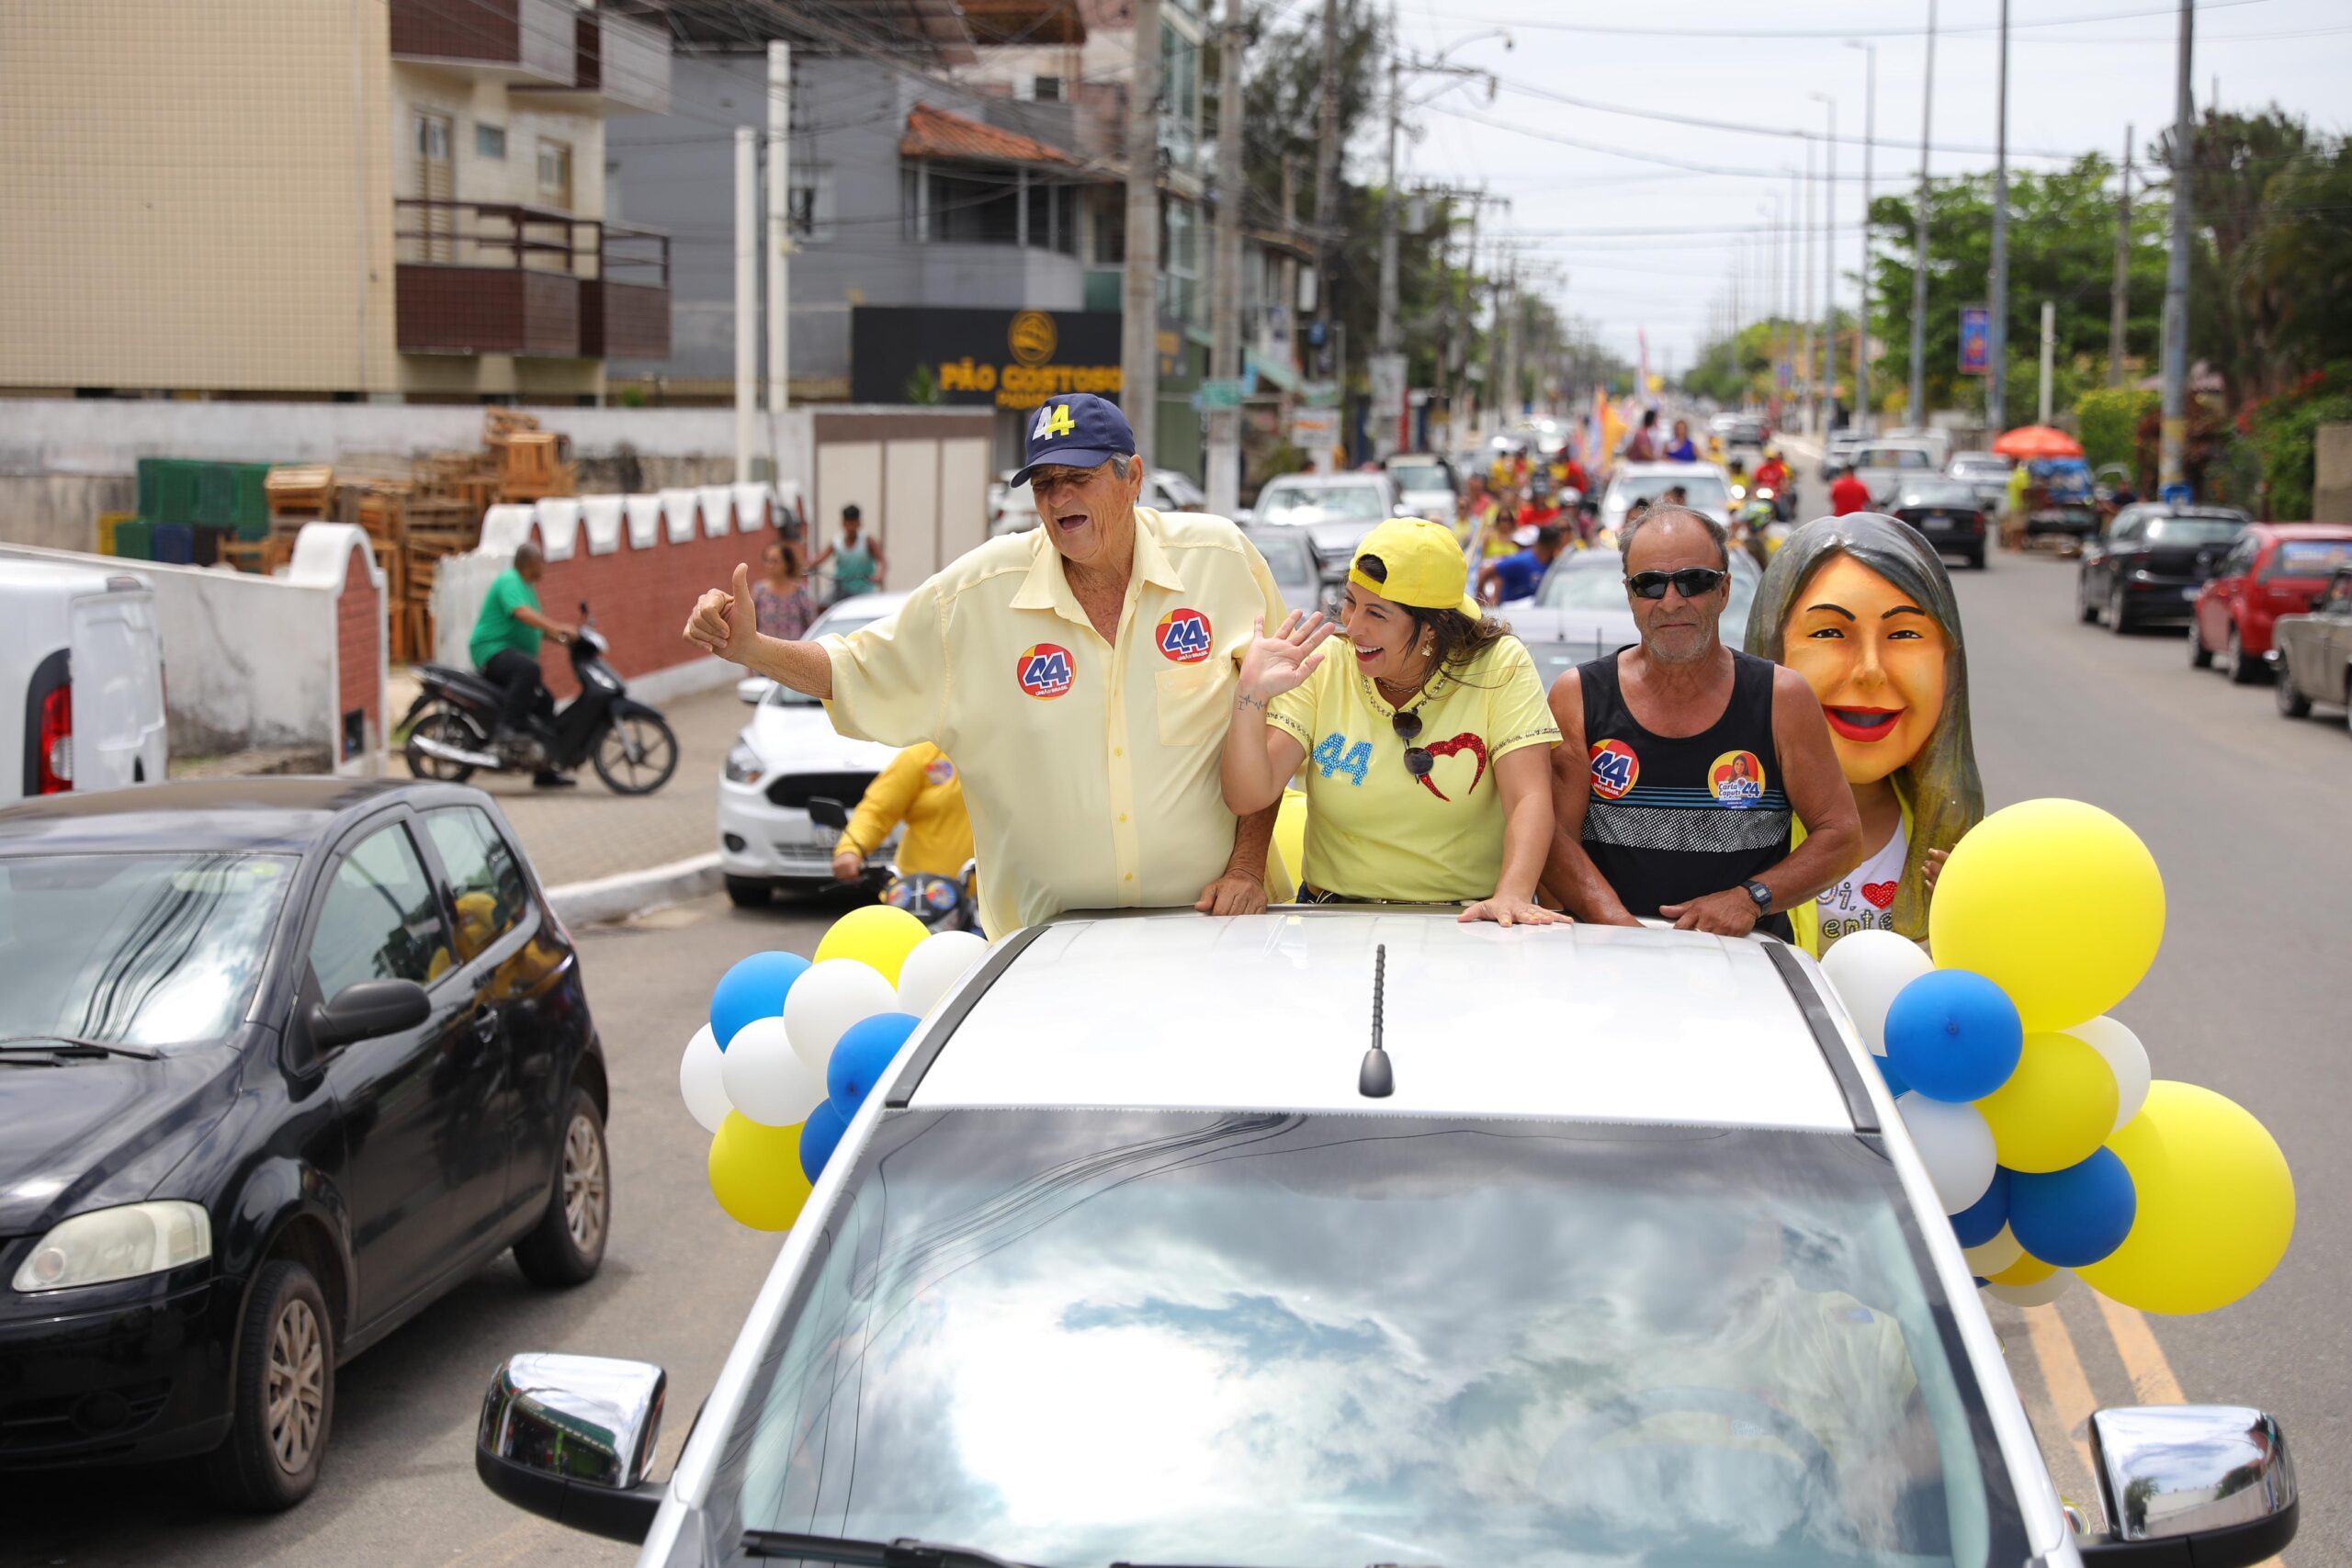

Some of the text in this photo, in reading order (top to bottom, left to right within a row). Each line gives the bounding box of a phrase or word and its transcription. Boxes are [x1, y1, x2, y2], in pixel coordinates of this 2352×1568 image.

[1032, 404, 1075, 441] 44
[1161, 616, 1211, 654] 44
[1023, 651, 1072, 689] 44
[1312, 732, 1373, 786] 44
[1591, 750, 1633, 791] 44
[1741, 782, 1760, 797] 44
